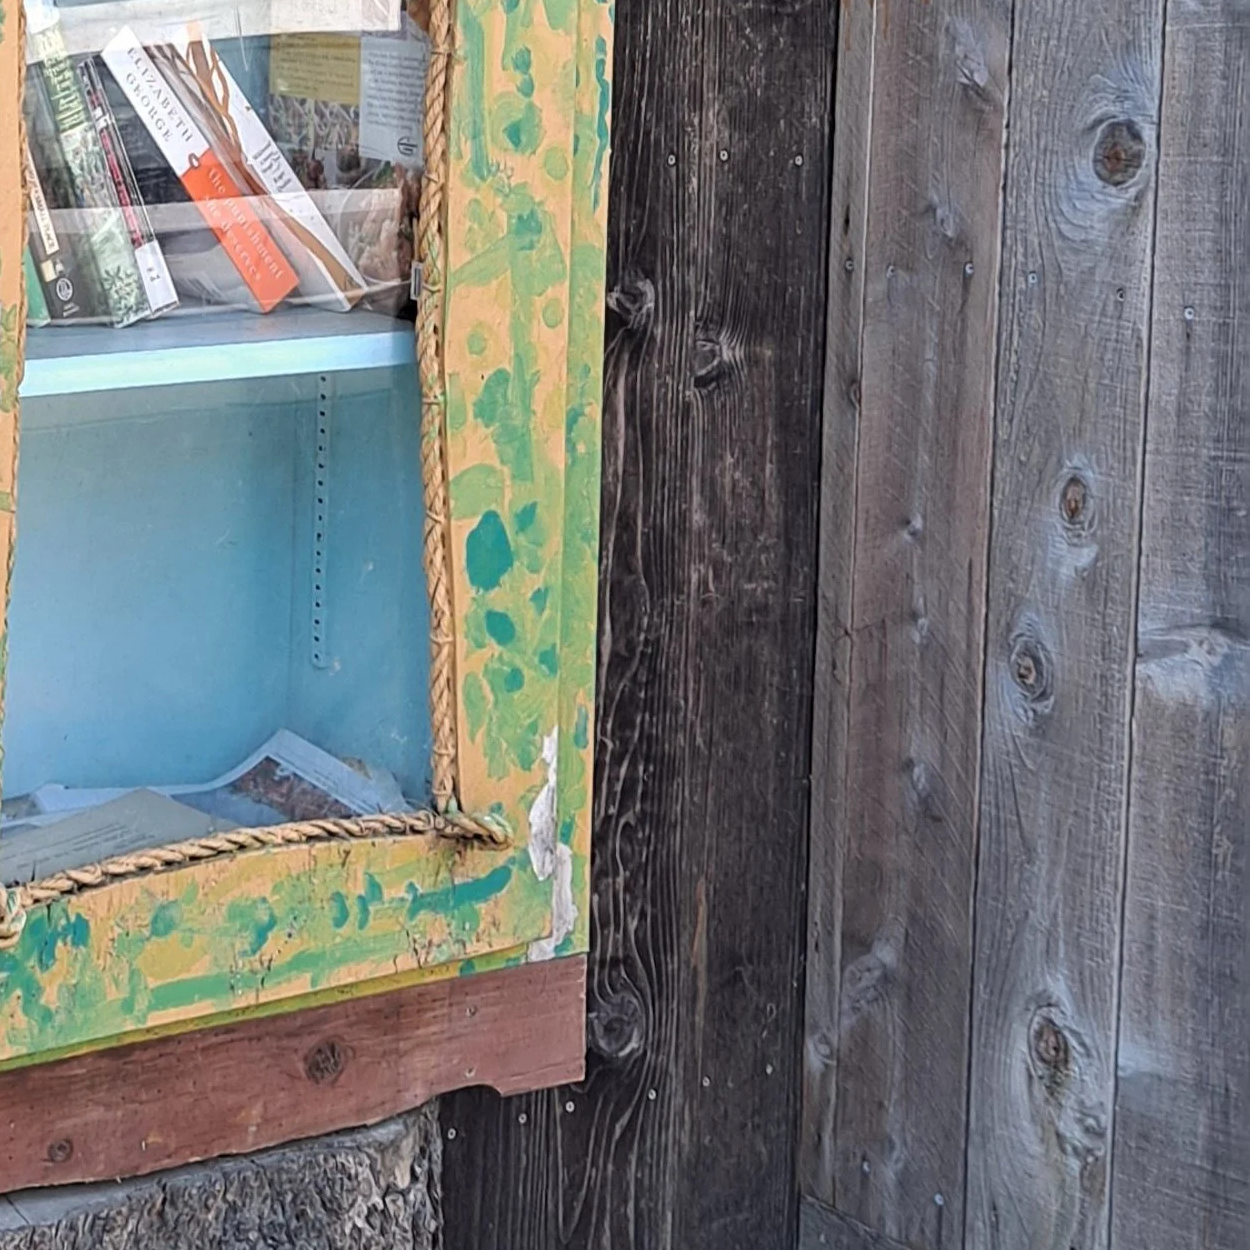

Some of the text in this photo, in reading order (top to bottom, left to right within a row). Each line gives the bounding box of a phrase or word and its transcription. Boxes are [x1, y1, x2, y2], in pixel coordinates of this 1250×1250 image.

[126, 73, 173, 144] GEORGE
[127, 47, 194, 143] ELIZABETH
[207, 168, 227, 194] the
[223, 197, 284, 280] punishment
[221, 219, 263, 282] deserves
